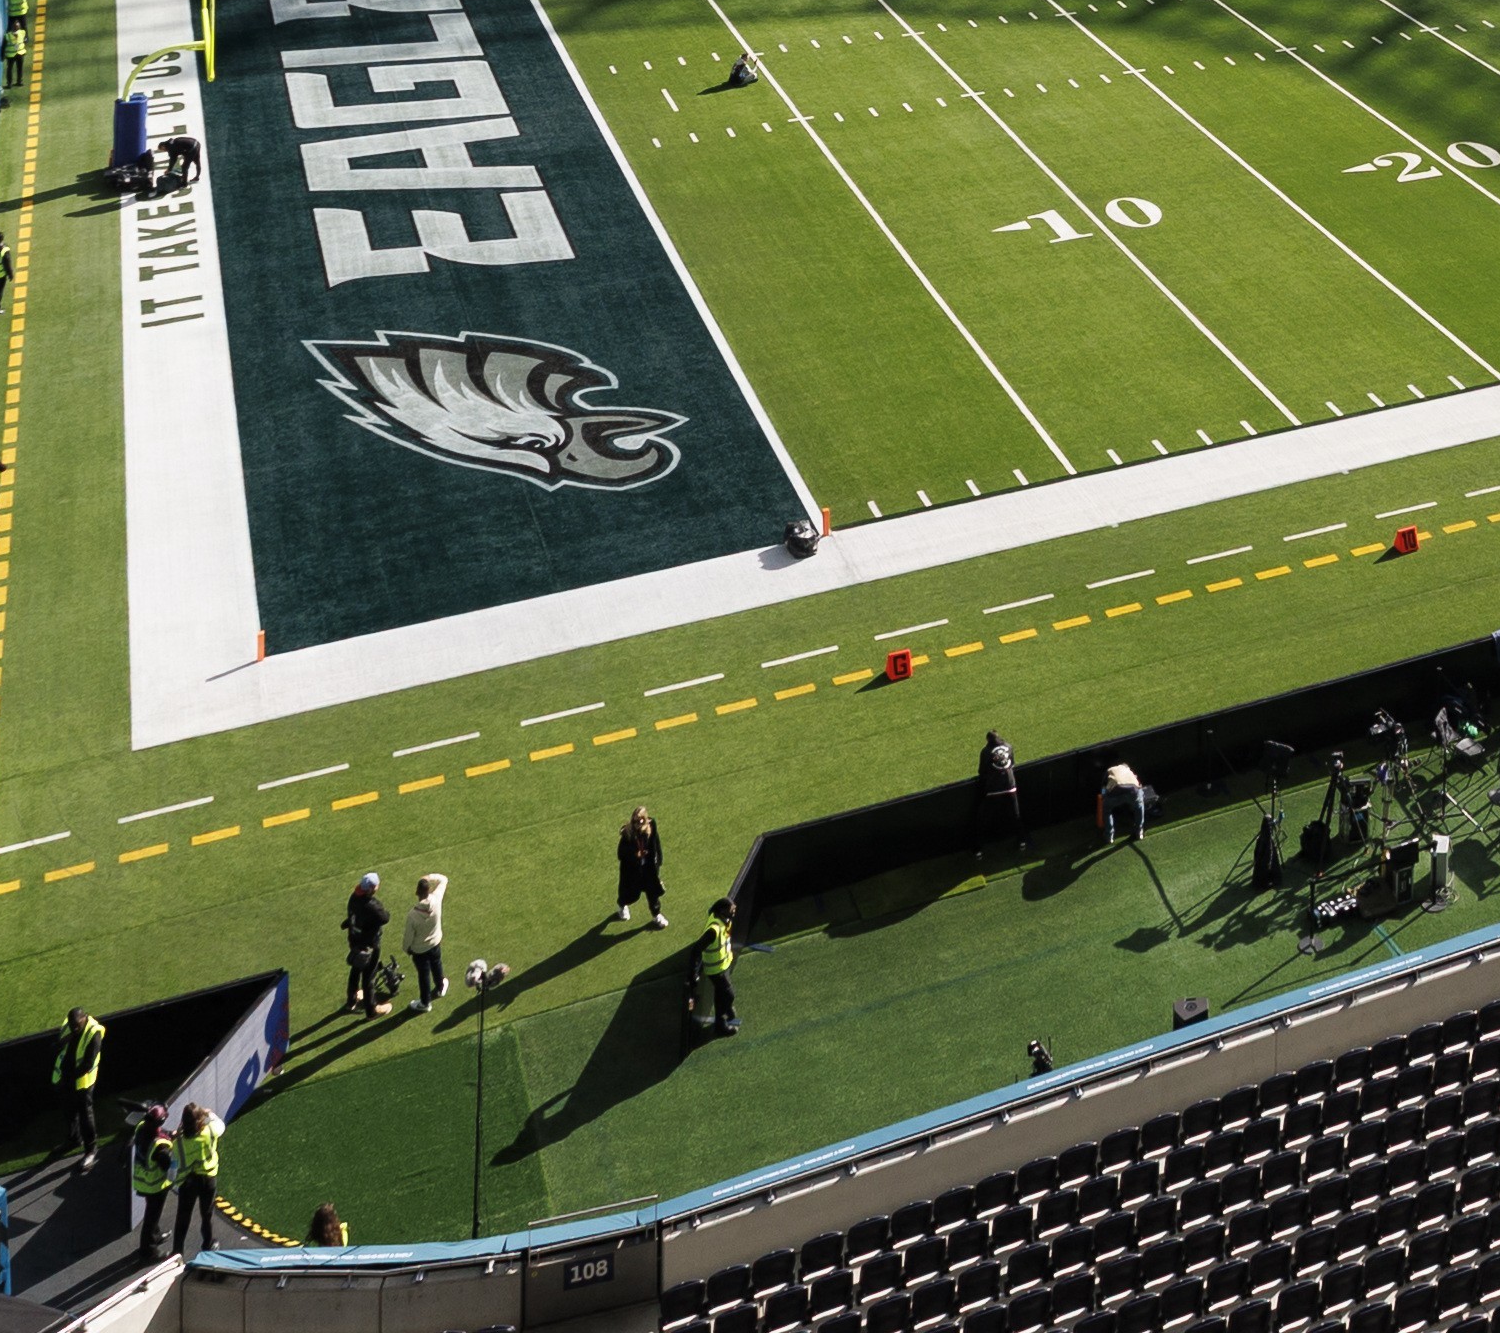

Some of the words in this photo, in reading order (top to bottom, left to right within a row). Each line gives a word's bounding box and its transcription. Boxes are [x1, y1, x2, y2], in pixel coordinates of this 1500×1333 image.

[1026, 196, 1164, 244] 10
[140, 293, 206, 330] IT
[1401, 529, 1420, 549] 10
[890, 651, 911, 678] G
[568, 1259, 609, 1284] 108
